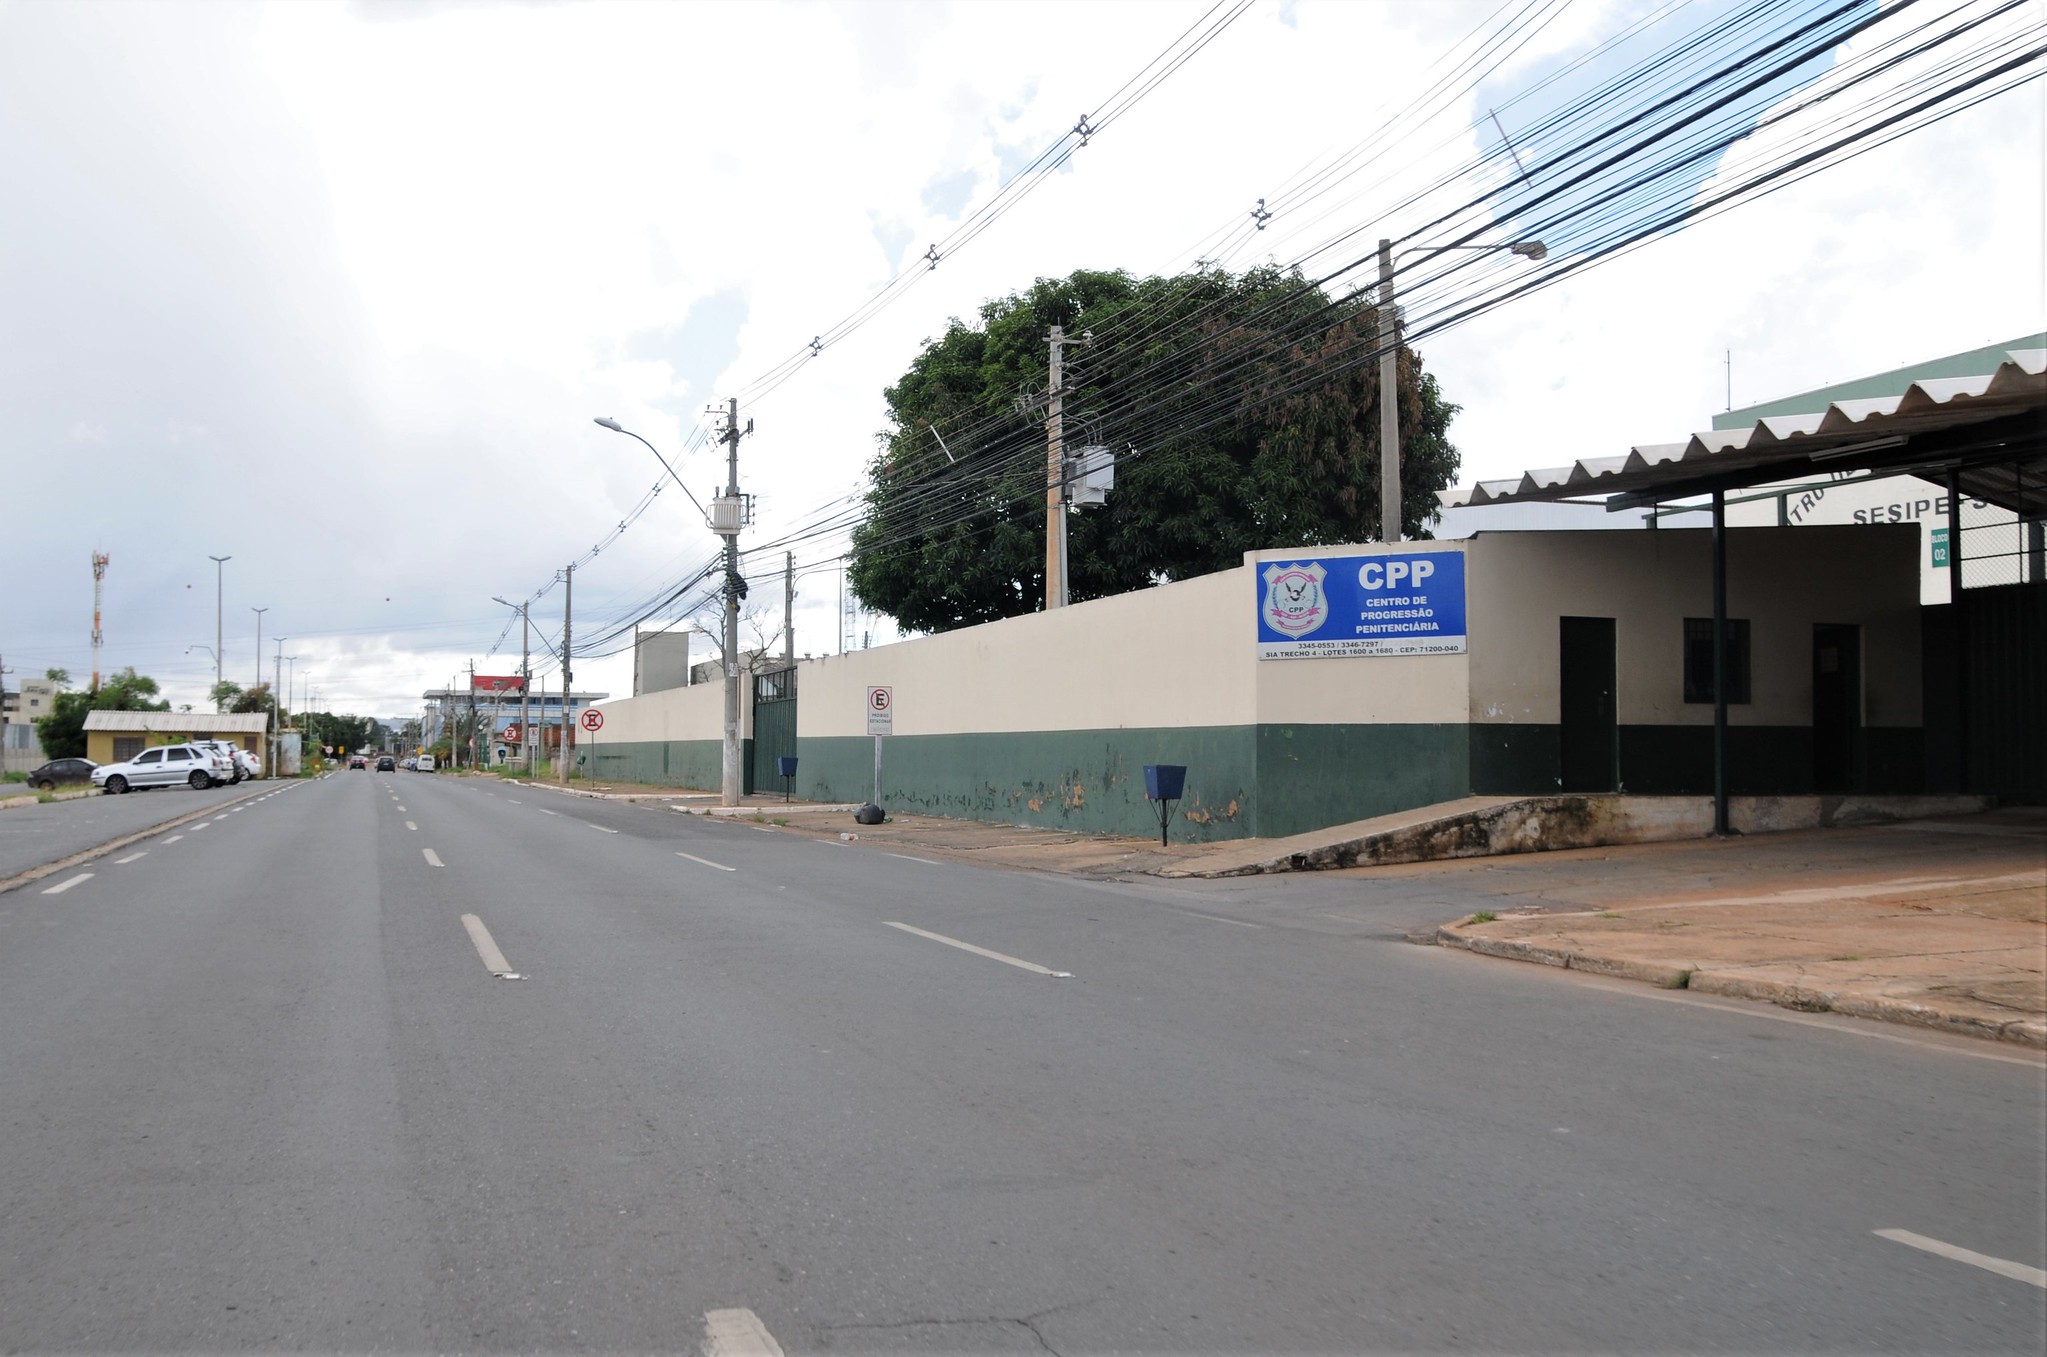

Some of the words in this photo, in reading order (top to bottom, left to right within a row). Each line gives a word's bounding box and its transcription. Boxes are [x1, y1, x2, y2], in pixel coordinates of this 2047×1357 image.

[1931, 533, 1949, 544] BLOCO
[1934, 548, 1946, 561] 02
[1358, 560, 1435, 591] CPP
[1366, 597, 1410, 607] CENTRO
[1412, 595, 1428, 605] DE
[1360, 607, 1434, 621] PROGRESSÃO
[1355, 621, 1440, 634] PENITENCIÁRIA
[876, 693, 885, 706] E
